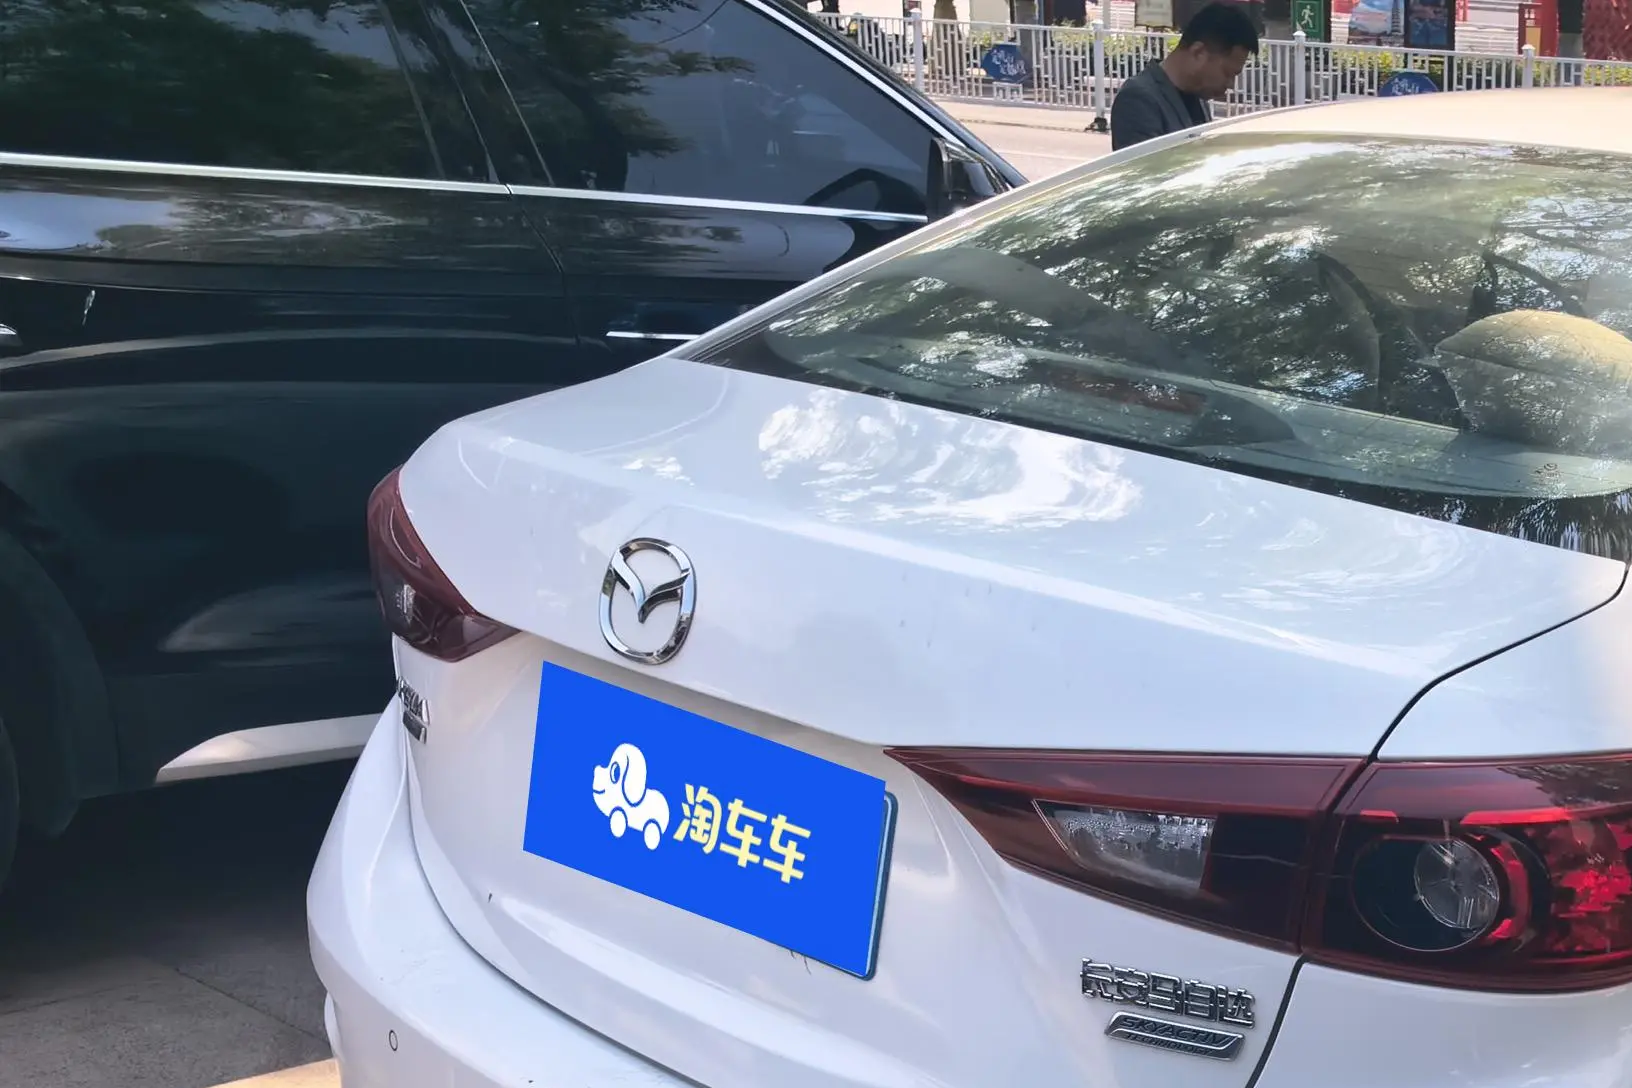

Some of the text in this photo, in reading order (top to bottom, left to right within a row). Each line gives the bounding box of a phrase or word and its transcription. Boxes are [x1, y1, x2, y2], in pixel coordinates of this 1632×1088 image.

[1080, 957, 1256, 1029] 长安马自达
[1119, 1015, 1231, 1047] SKYACTIV
